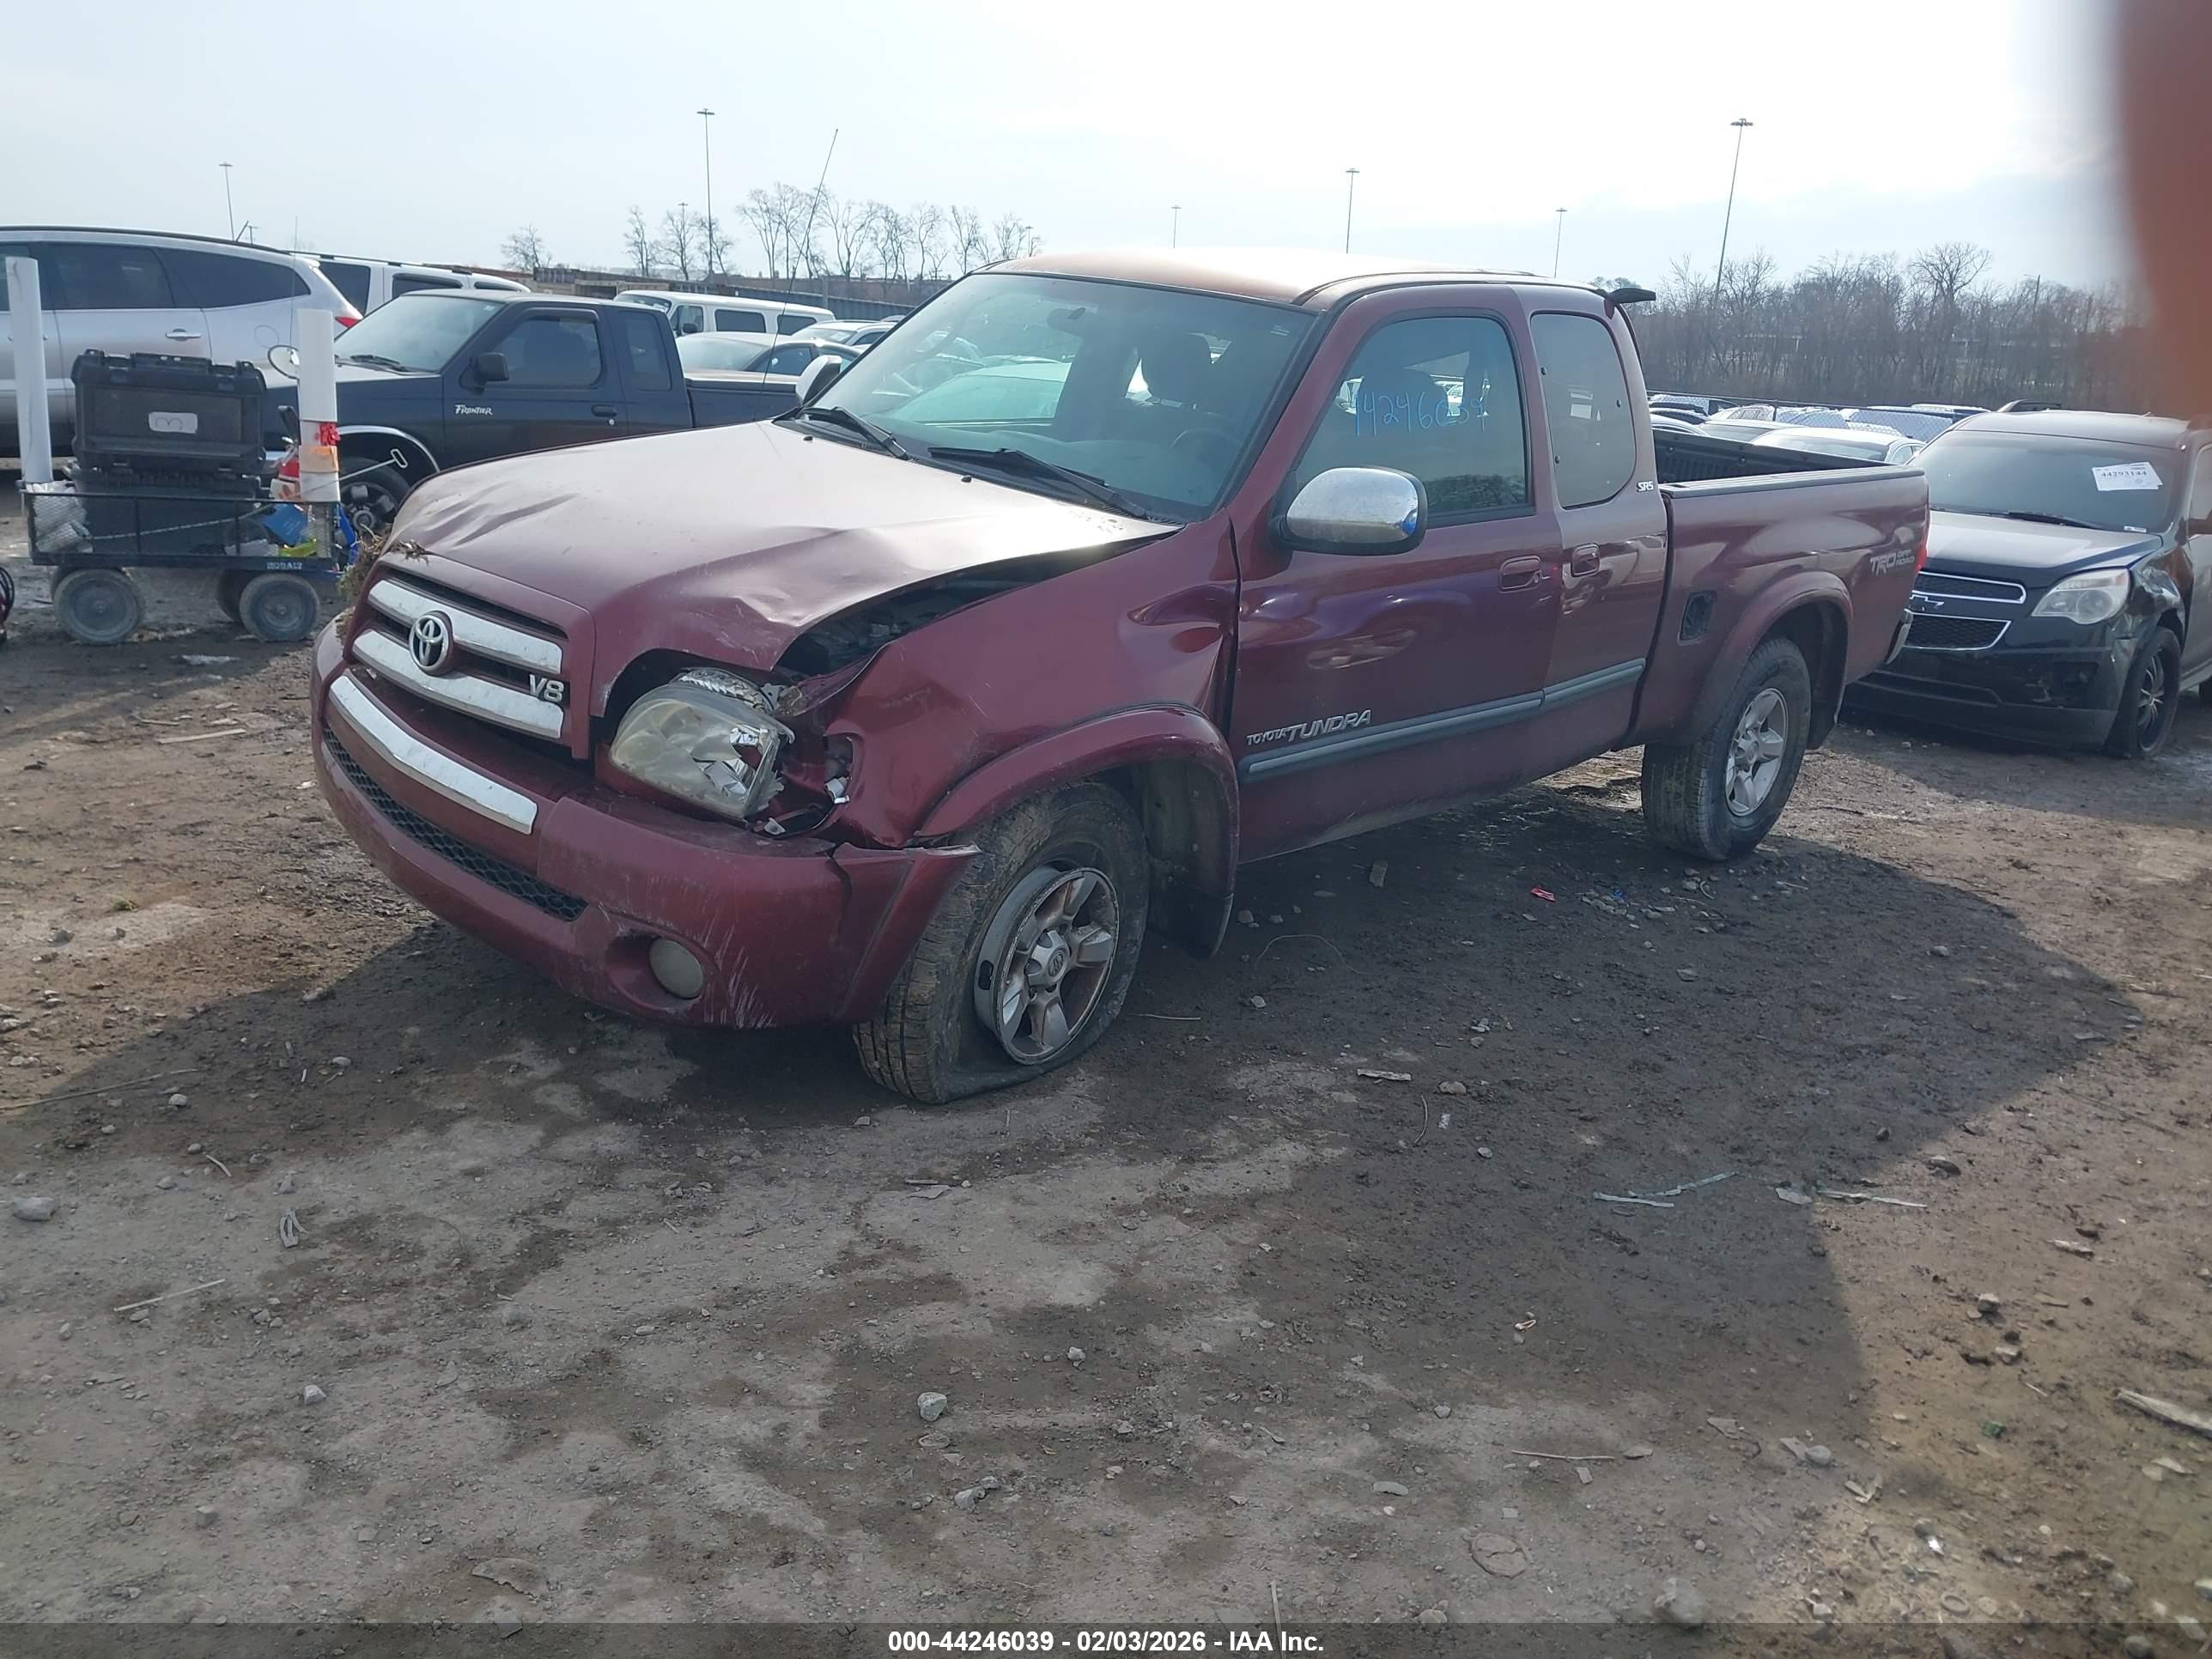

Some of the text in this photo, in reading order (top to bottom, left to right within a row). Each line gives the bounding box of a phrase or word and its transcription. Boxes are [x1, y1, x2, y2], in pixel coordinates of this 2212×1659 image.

[1870, 553, 1896, 576] TRD
[529, 674, 564, 702] V8
[1247, 709, 1371, 746] TOYOTA TUNDRA
